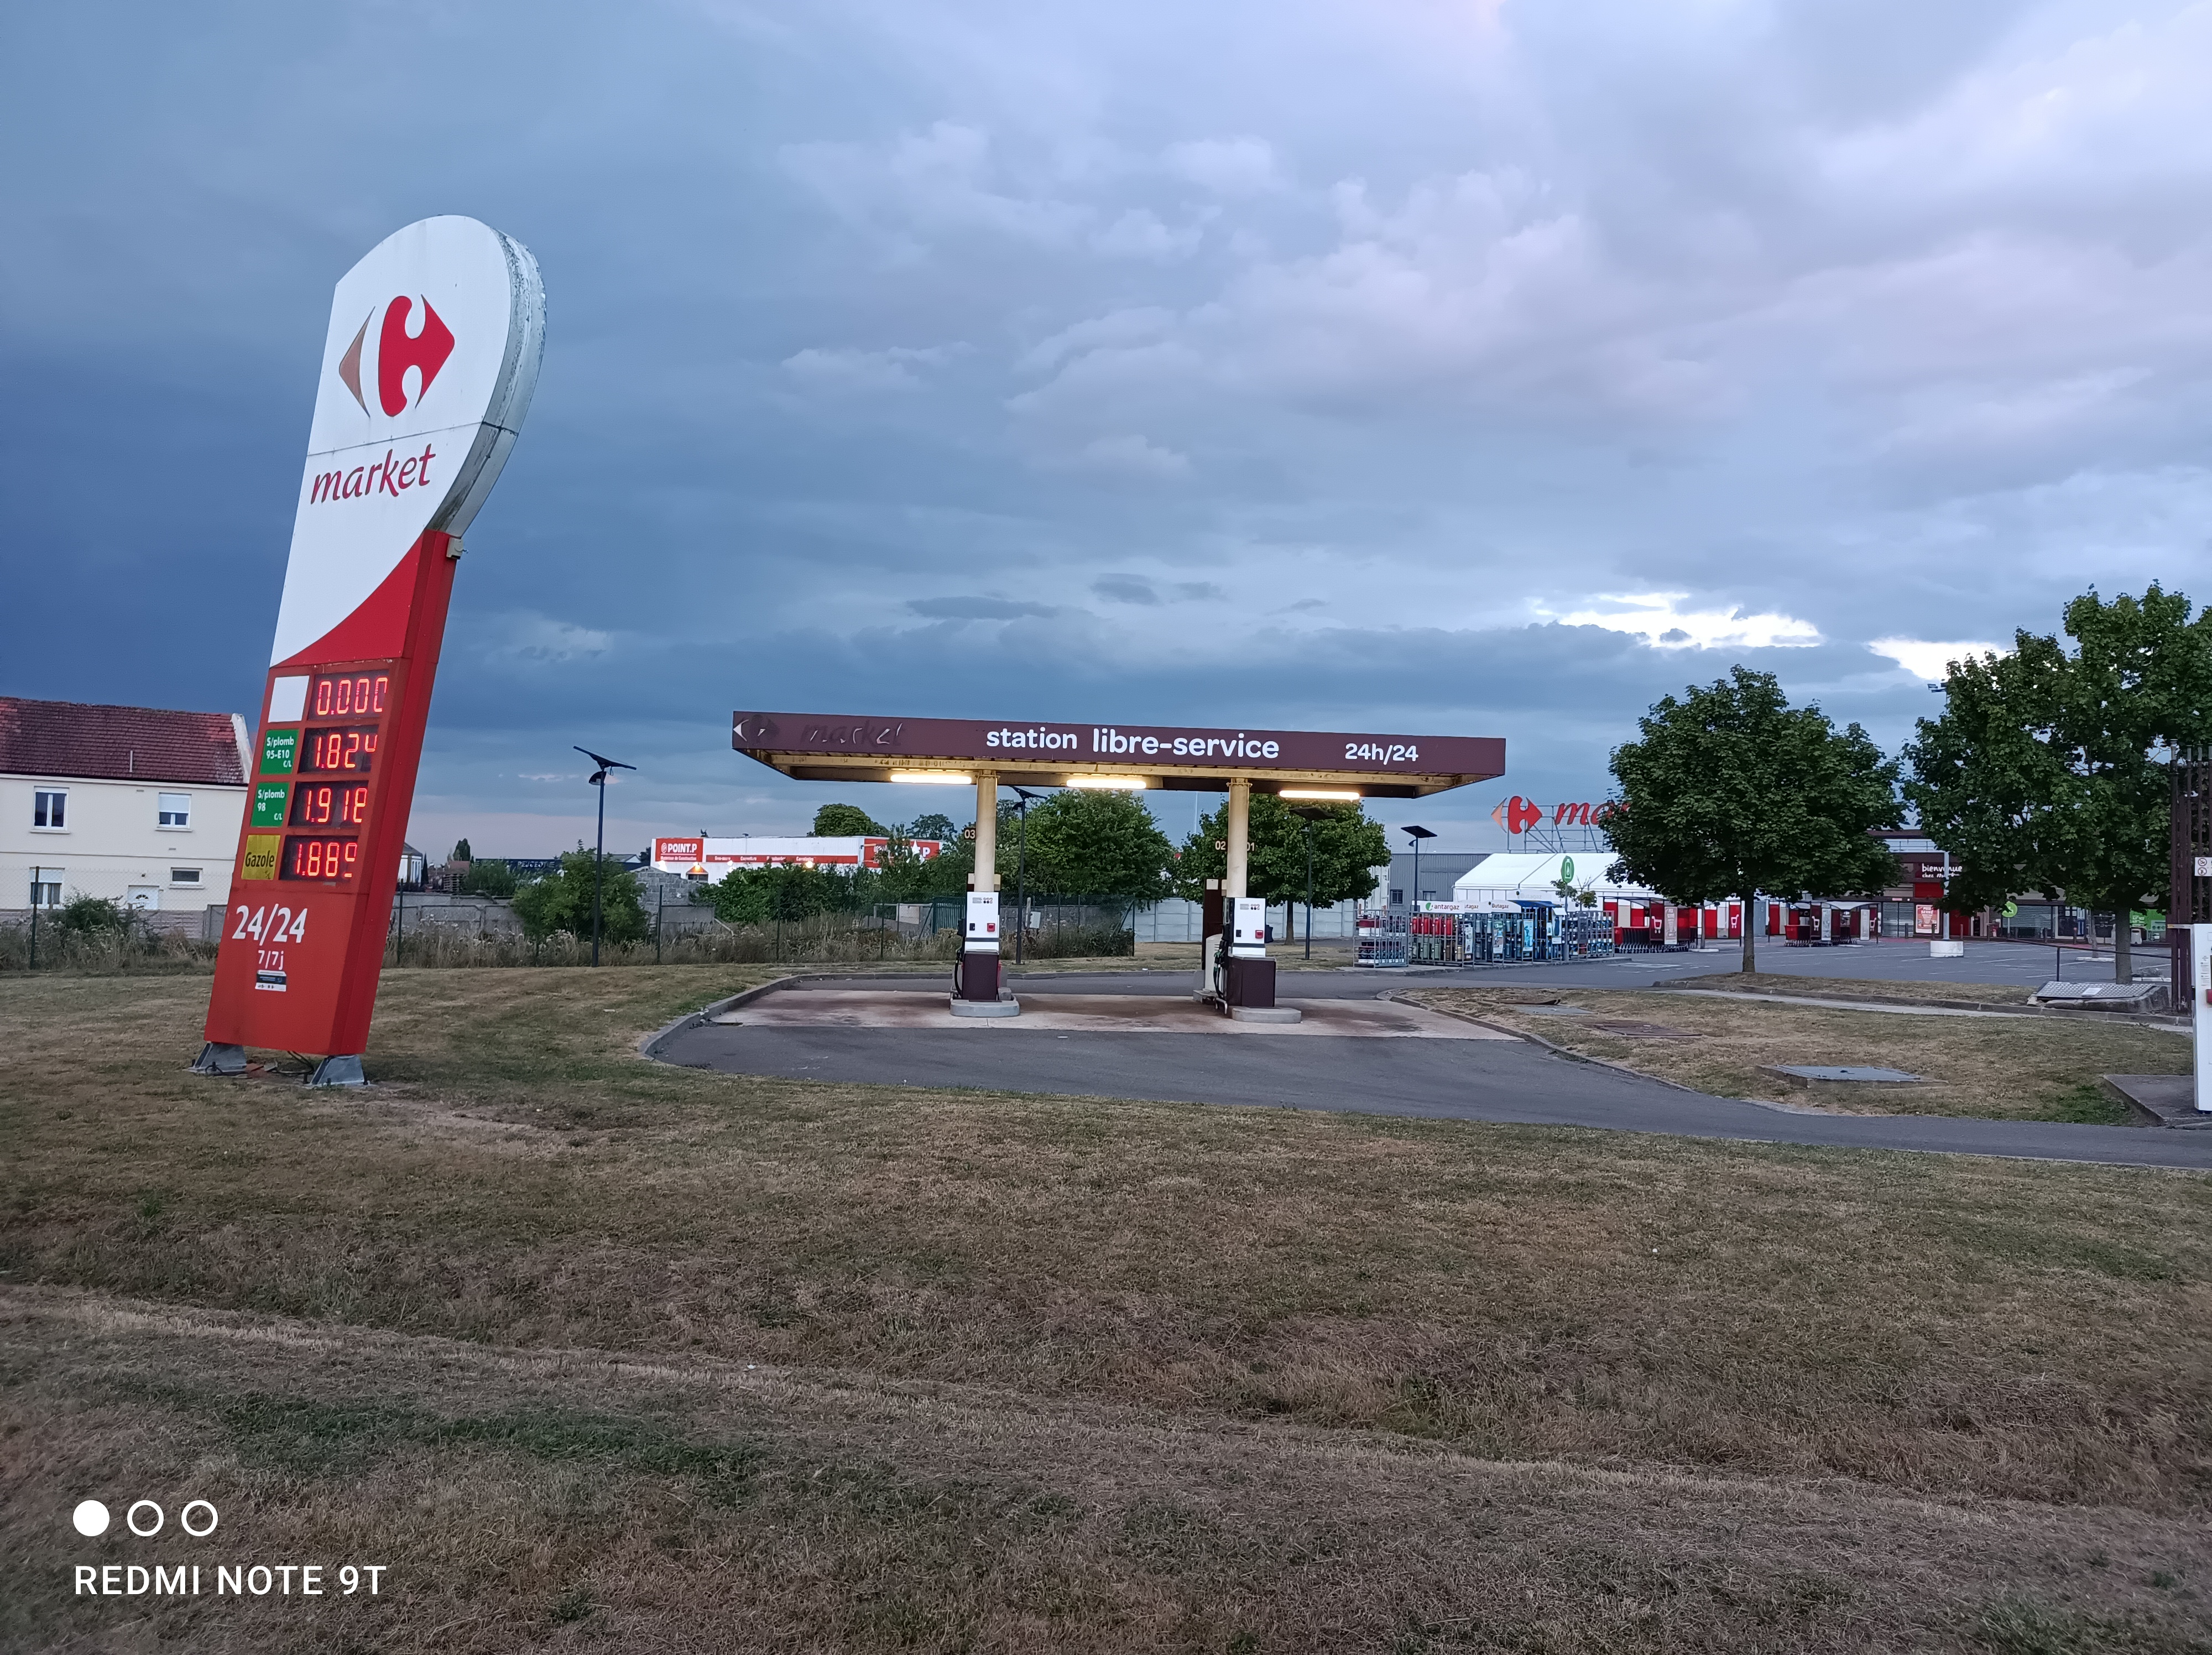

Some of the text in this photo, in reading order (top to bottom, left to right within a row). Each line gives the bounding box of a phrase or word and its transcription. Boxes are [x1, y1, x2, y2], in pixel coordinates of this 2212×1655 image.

[310, 444, 436, 504] market
[267, 736, 294, 748] S/plomb
[987, 727, 1418, 765] station libre-service 24h/24
[266, 750, 290, 759] 95-E10
[258, 789, 285, 801] S/plomb
[257, 802, 266, 811] 98
[964, 829, 975, 839] 03
[1215, 841, 1226, 850] 02
[245, 850, 275, 867] Gazole
[232, 903, 308, 946] 24/24
[258, 950, 284, 970] 7/7j
